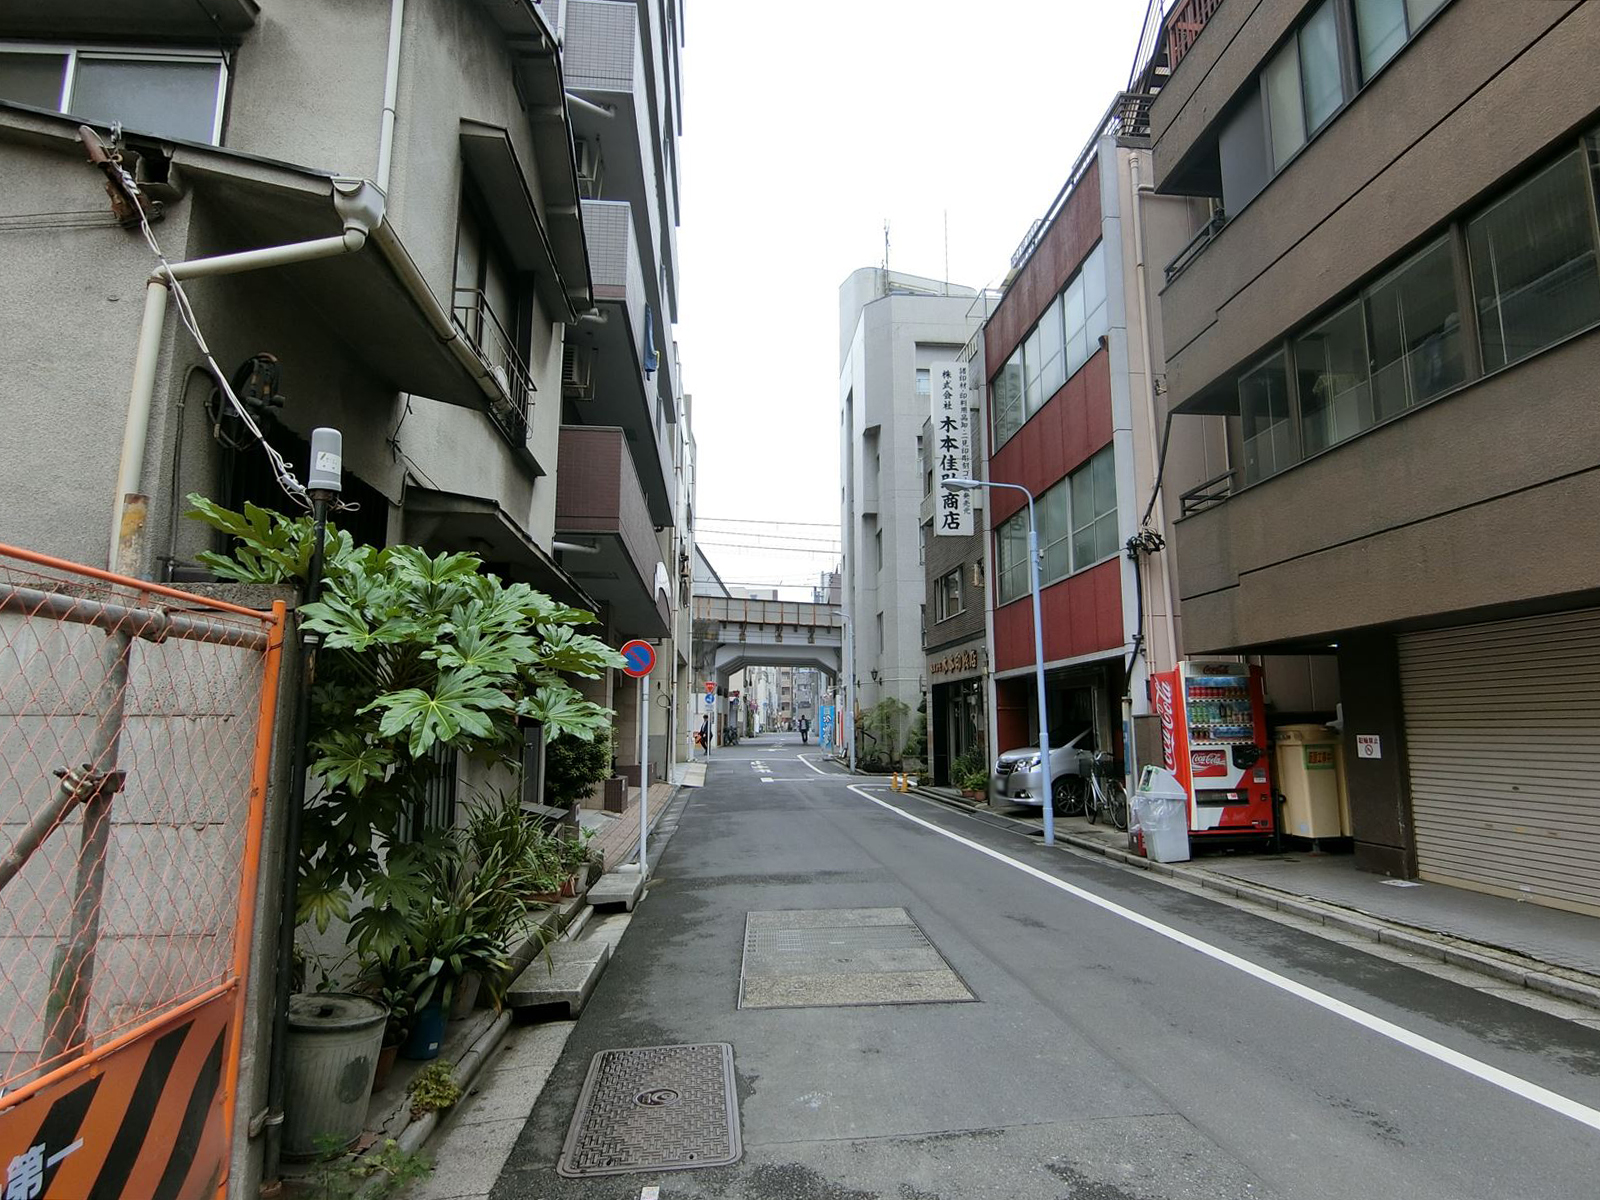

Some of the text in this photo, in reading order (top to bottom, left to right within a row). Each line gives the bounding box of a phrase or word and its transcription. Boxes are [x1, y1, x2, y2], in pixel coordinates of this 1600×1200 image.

[942, 369, 953, 410] 株式会社
[6, 1137, 84, 1200] 第一
